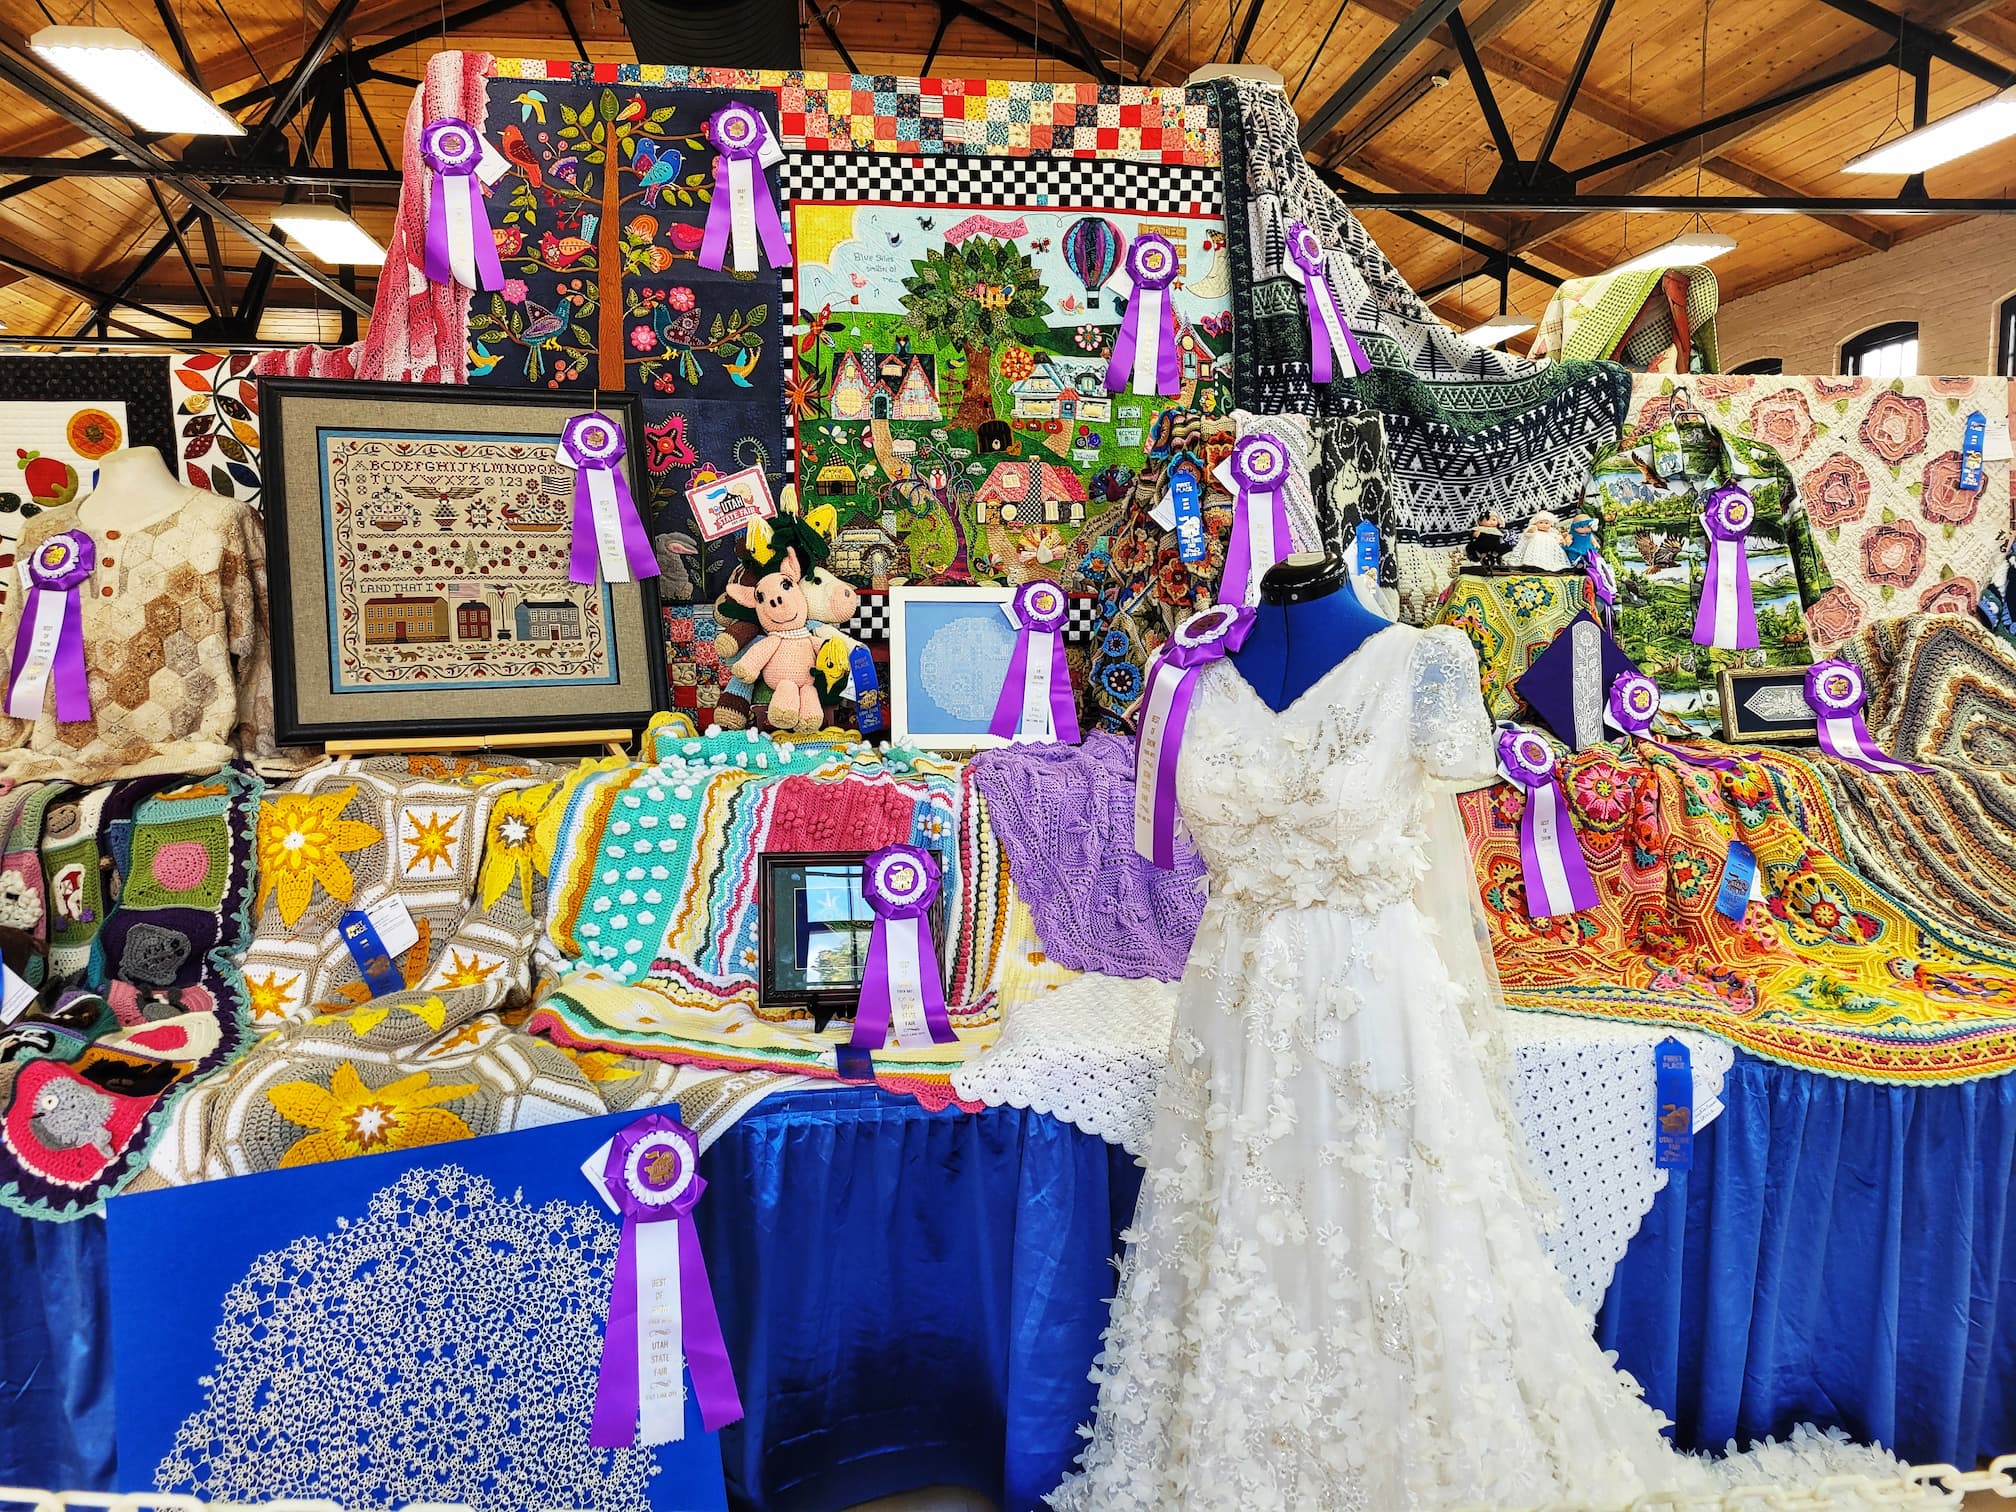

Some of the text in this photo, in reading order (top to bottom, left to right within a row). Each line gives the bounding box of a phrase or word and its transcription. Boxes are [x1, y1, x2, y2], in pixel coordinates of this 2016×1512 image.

[499, 476, 523, 487] 123
[720, 496, 744, 513] UTAH
[718, 512, 739, 526] STATE
[740, 507, 755, 517] FAIR
[360, 582, 434, 593] LAND THAT I
[1663, 1062, 1685, 1070] PLACE
[651, 1279, 666, 1289] BEST
[651, 1341, 669, 1351] UTAH
[651, 1354, 670, 1365] STATE
[653, 1366, 668, 1377] FAIR
